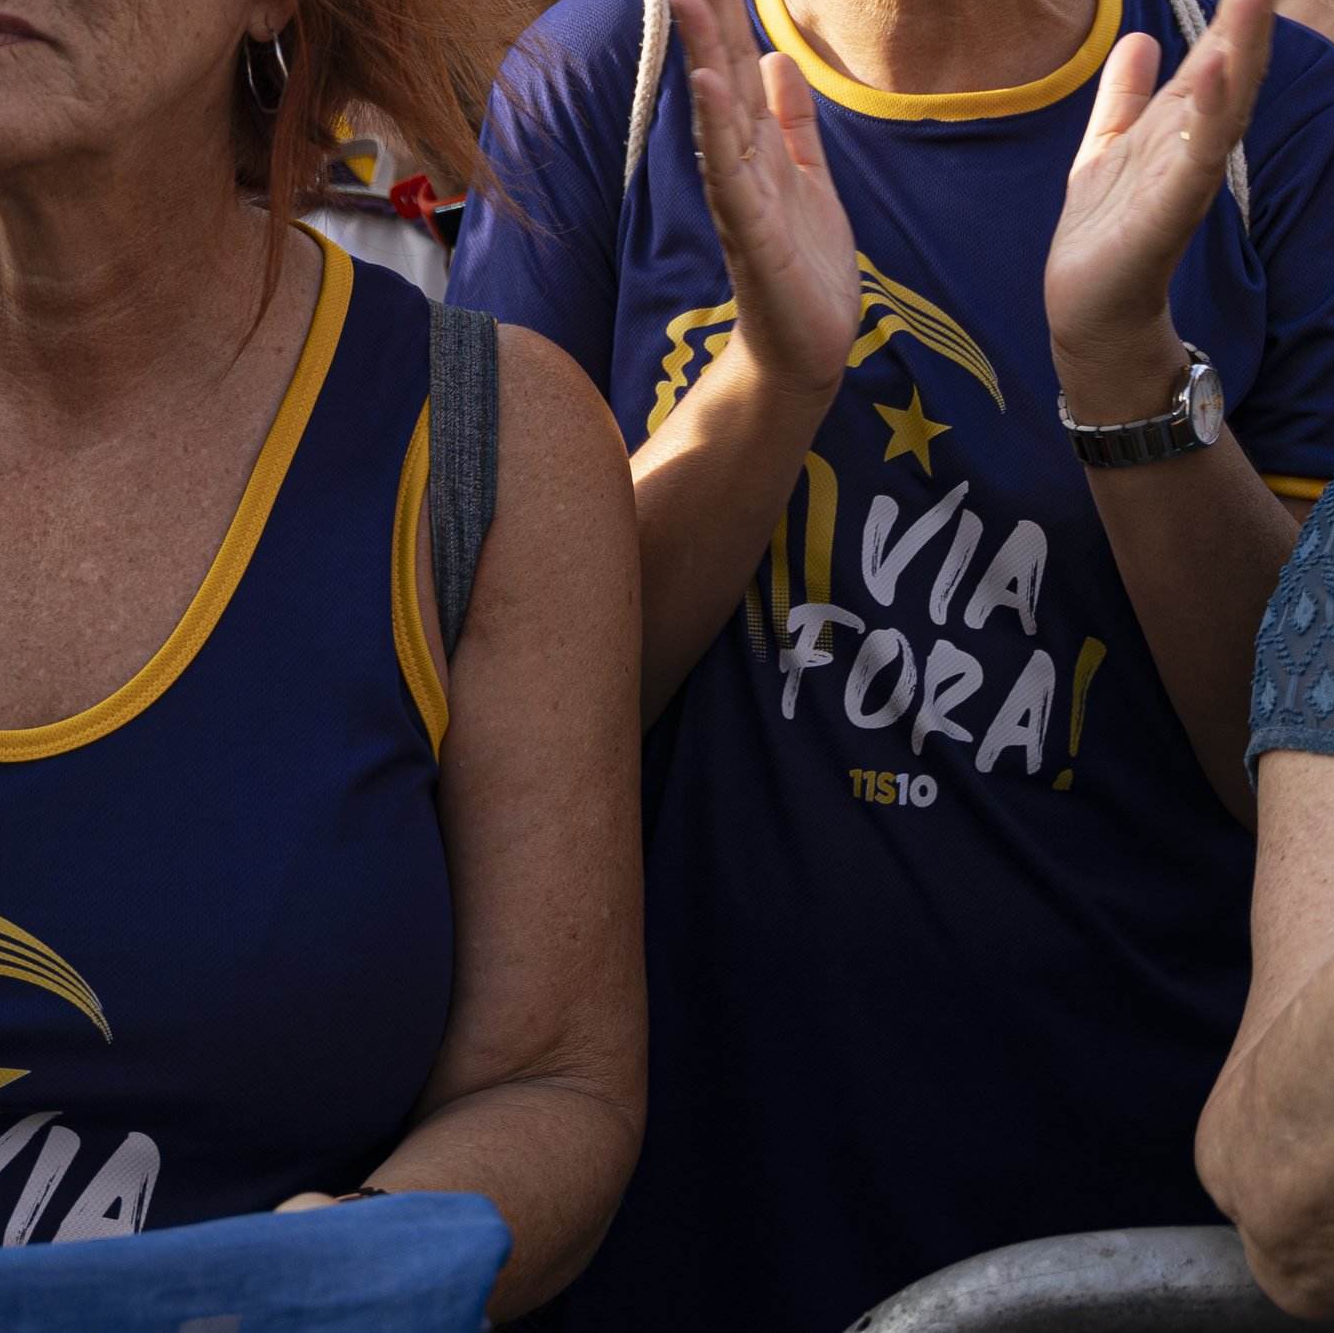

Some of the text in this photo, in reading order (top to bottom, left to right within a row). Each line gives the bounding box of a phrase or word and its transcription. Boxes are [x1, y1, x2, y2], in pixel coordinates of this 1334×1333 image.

[862, 481, 1047, 635] VIA
[779, 603, 1106, 791] FORA!
[848, 767, 938, 808] 11S10
